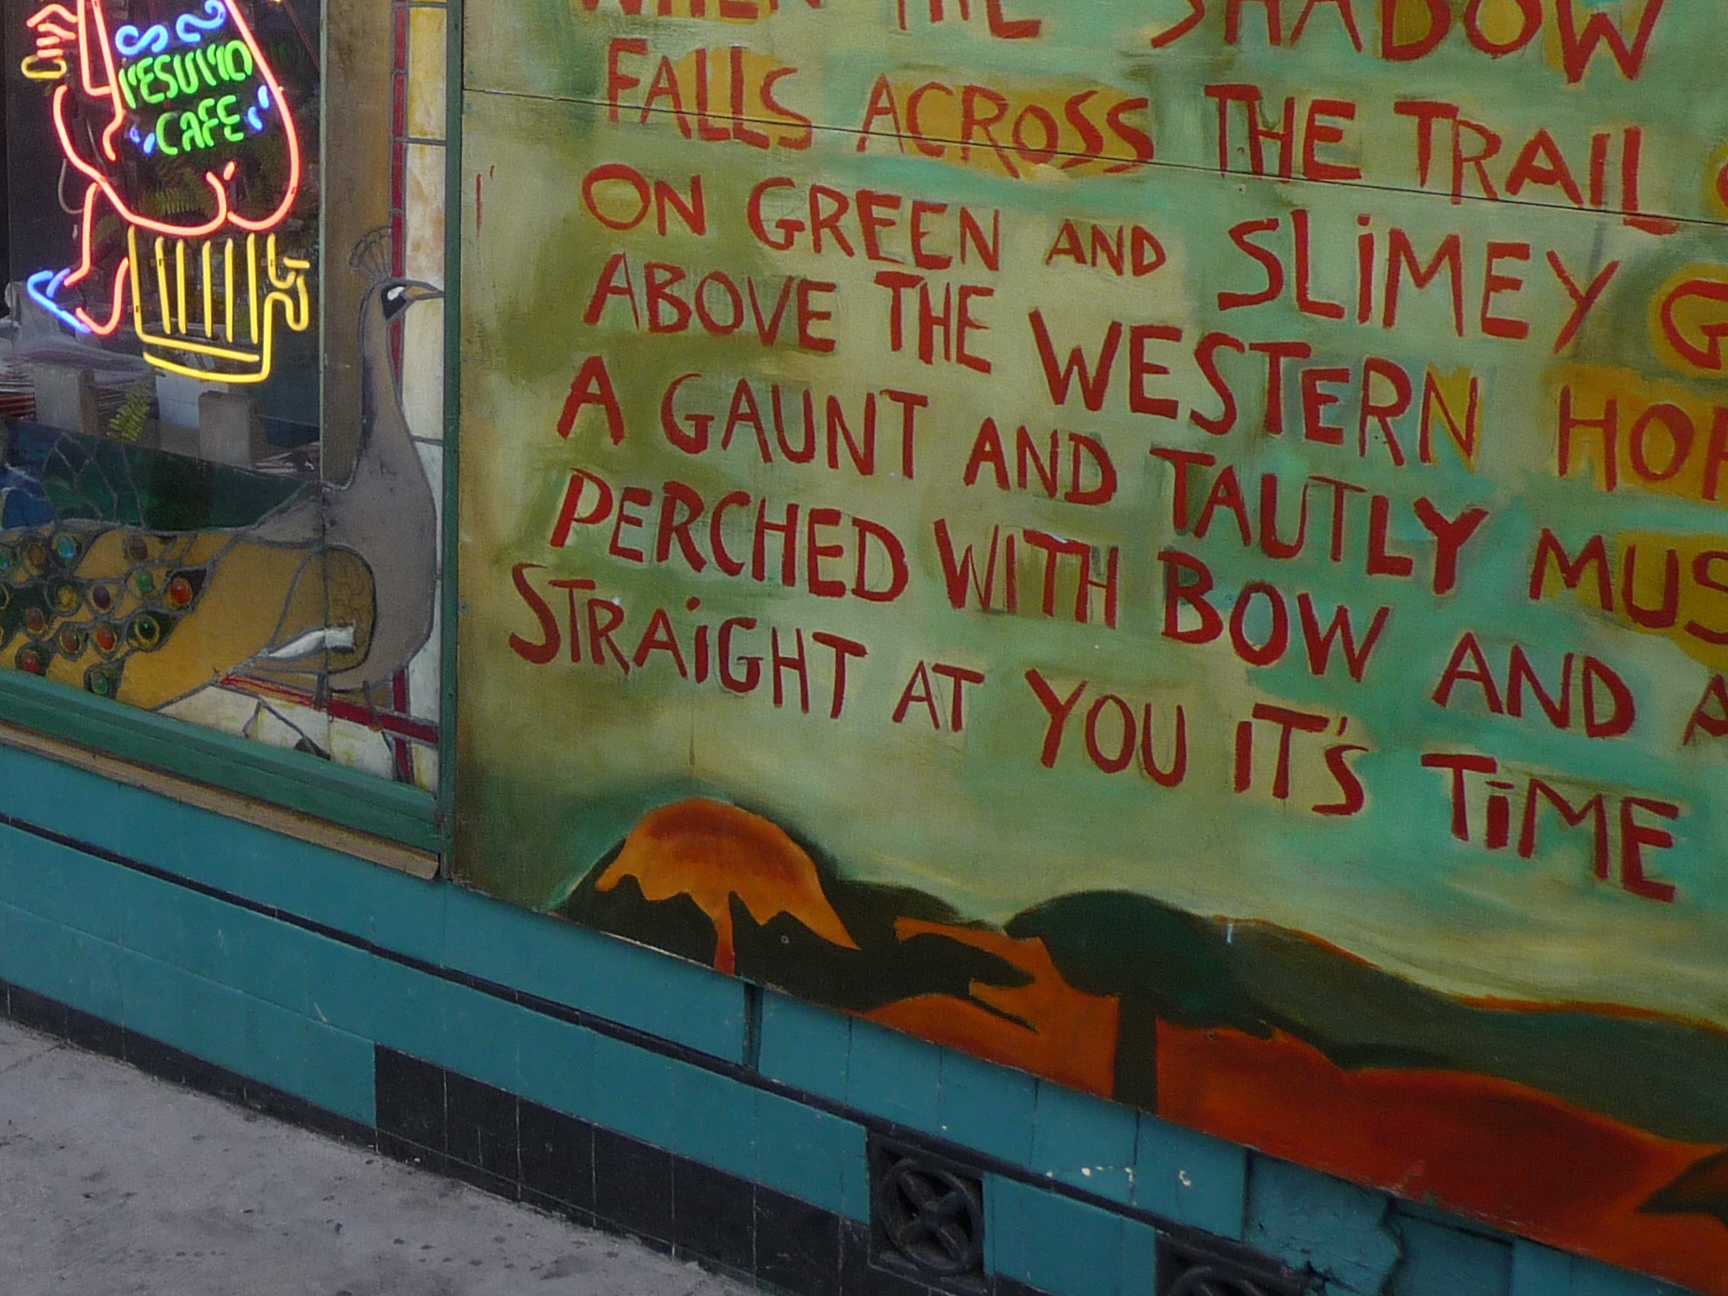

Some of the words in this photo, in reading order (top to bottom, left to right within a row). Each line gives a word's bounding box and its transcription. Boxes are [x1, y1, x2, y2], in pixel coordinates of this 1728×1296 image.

[118, 39, 254, 109] VESUVIO
[155, 94, 245, 156] CAFE
[606, 36, 814, 151] FALLS
[855, 72, 1156, 180] ACROSS
[1203, 82, 1363, 184] THE
[1392, 100, 1680, 237] TRAIL
[581, 162, 706, 237] ON
[745, 176, 1001, 272] GREEN
[1044, 218, 1168, 279] AND
[582, 251, 838, 355] ABOVE
[873, 271, 992, 374] THE
[1029, 309, 1480, 467] WESTERN
[556, 354, 626, 446] A
[659, 372, 929, 480] GAUNT
[962, 416, 1118, 506] AND
[1149, 447, 1490, 595] TAUTLY
[548, 466, 910, 603] PERCHED
[933, 518, 1120, 630] WITH
[1156, 549, 1392, 683] BOW
[1431, 631, 1637, 739] AND
[891, 659, 986, 733] AT
[1024, 666, 1188, 789] YOU
[1233, 702, 1370, 816] IT'S
